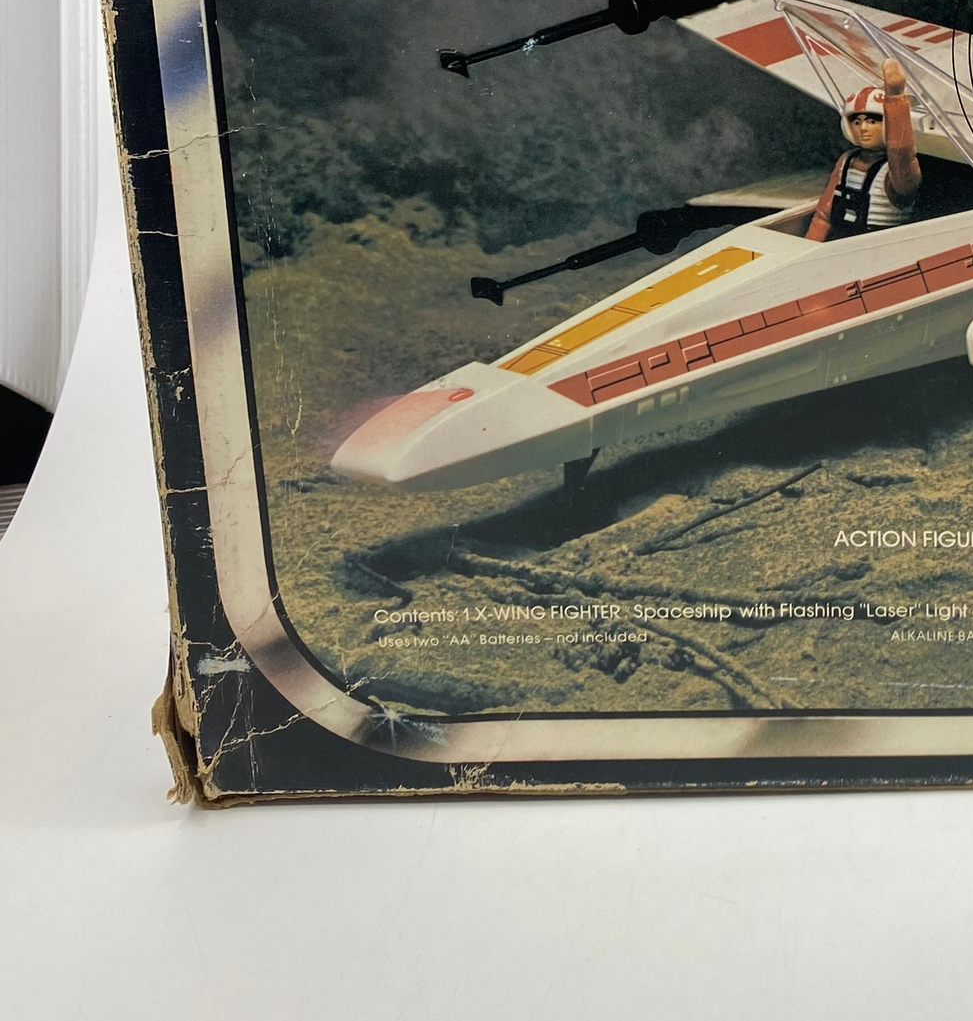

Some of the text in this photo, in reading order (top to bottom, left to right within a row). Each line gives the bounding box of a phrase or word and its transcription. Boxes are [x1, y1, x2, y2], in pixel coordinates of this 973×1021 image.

[834, 530, 916, 548] ACTION
[374, 608, 459, 623] Contents:
[462, 607, 470, 621] 1
[475, 605, 546, 621] X-WING
[634, 603, 732, 622] Spaceship
[739, 603, 776, 618] with
[780, 603, 855, 621] Flashing
[859, 602, 921, 618] "Laser"
[926, 604, 968, 620] Light
[378, 636, 411, 648] Uses
[413, 636, 440, 647] two
[479, 633, 541, 645] Batteries
[557, 632, 580, 644] not
[582, 631, 648, 643] included
[890, 630, 954, 642] ALKALINE
